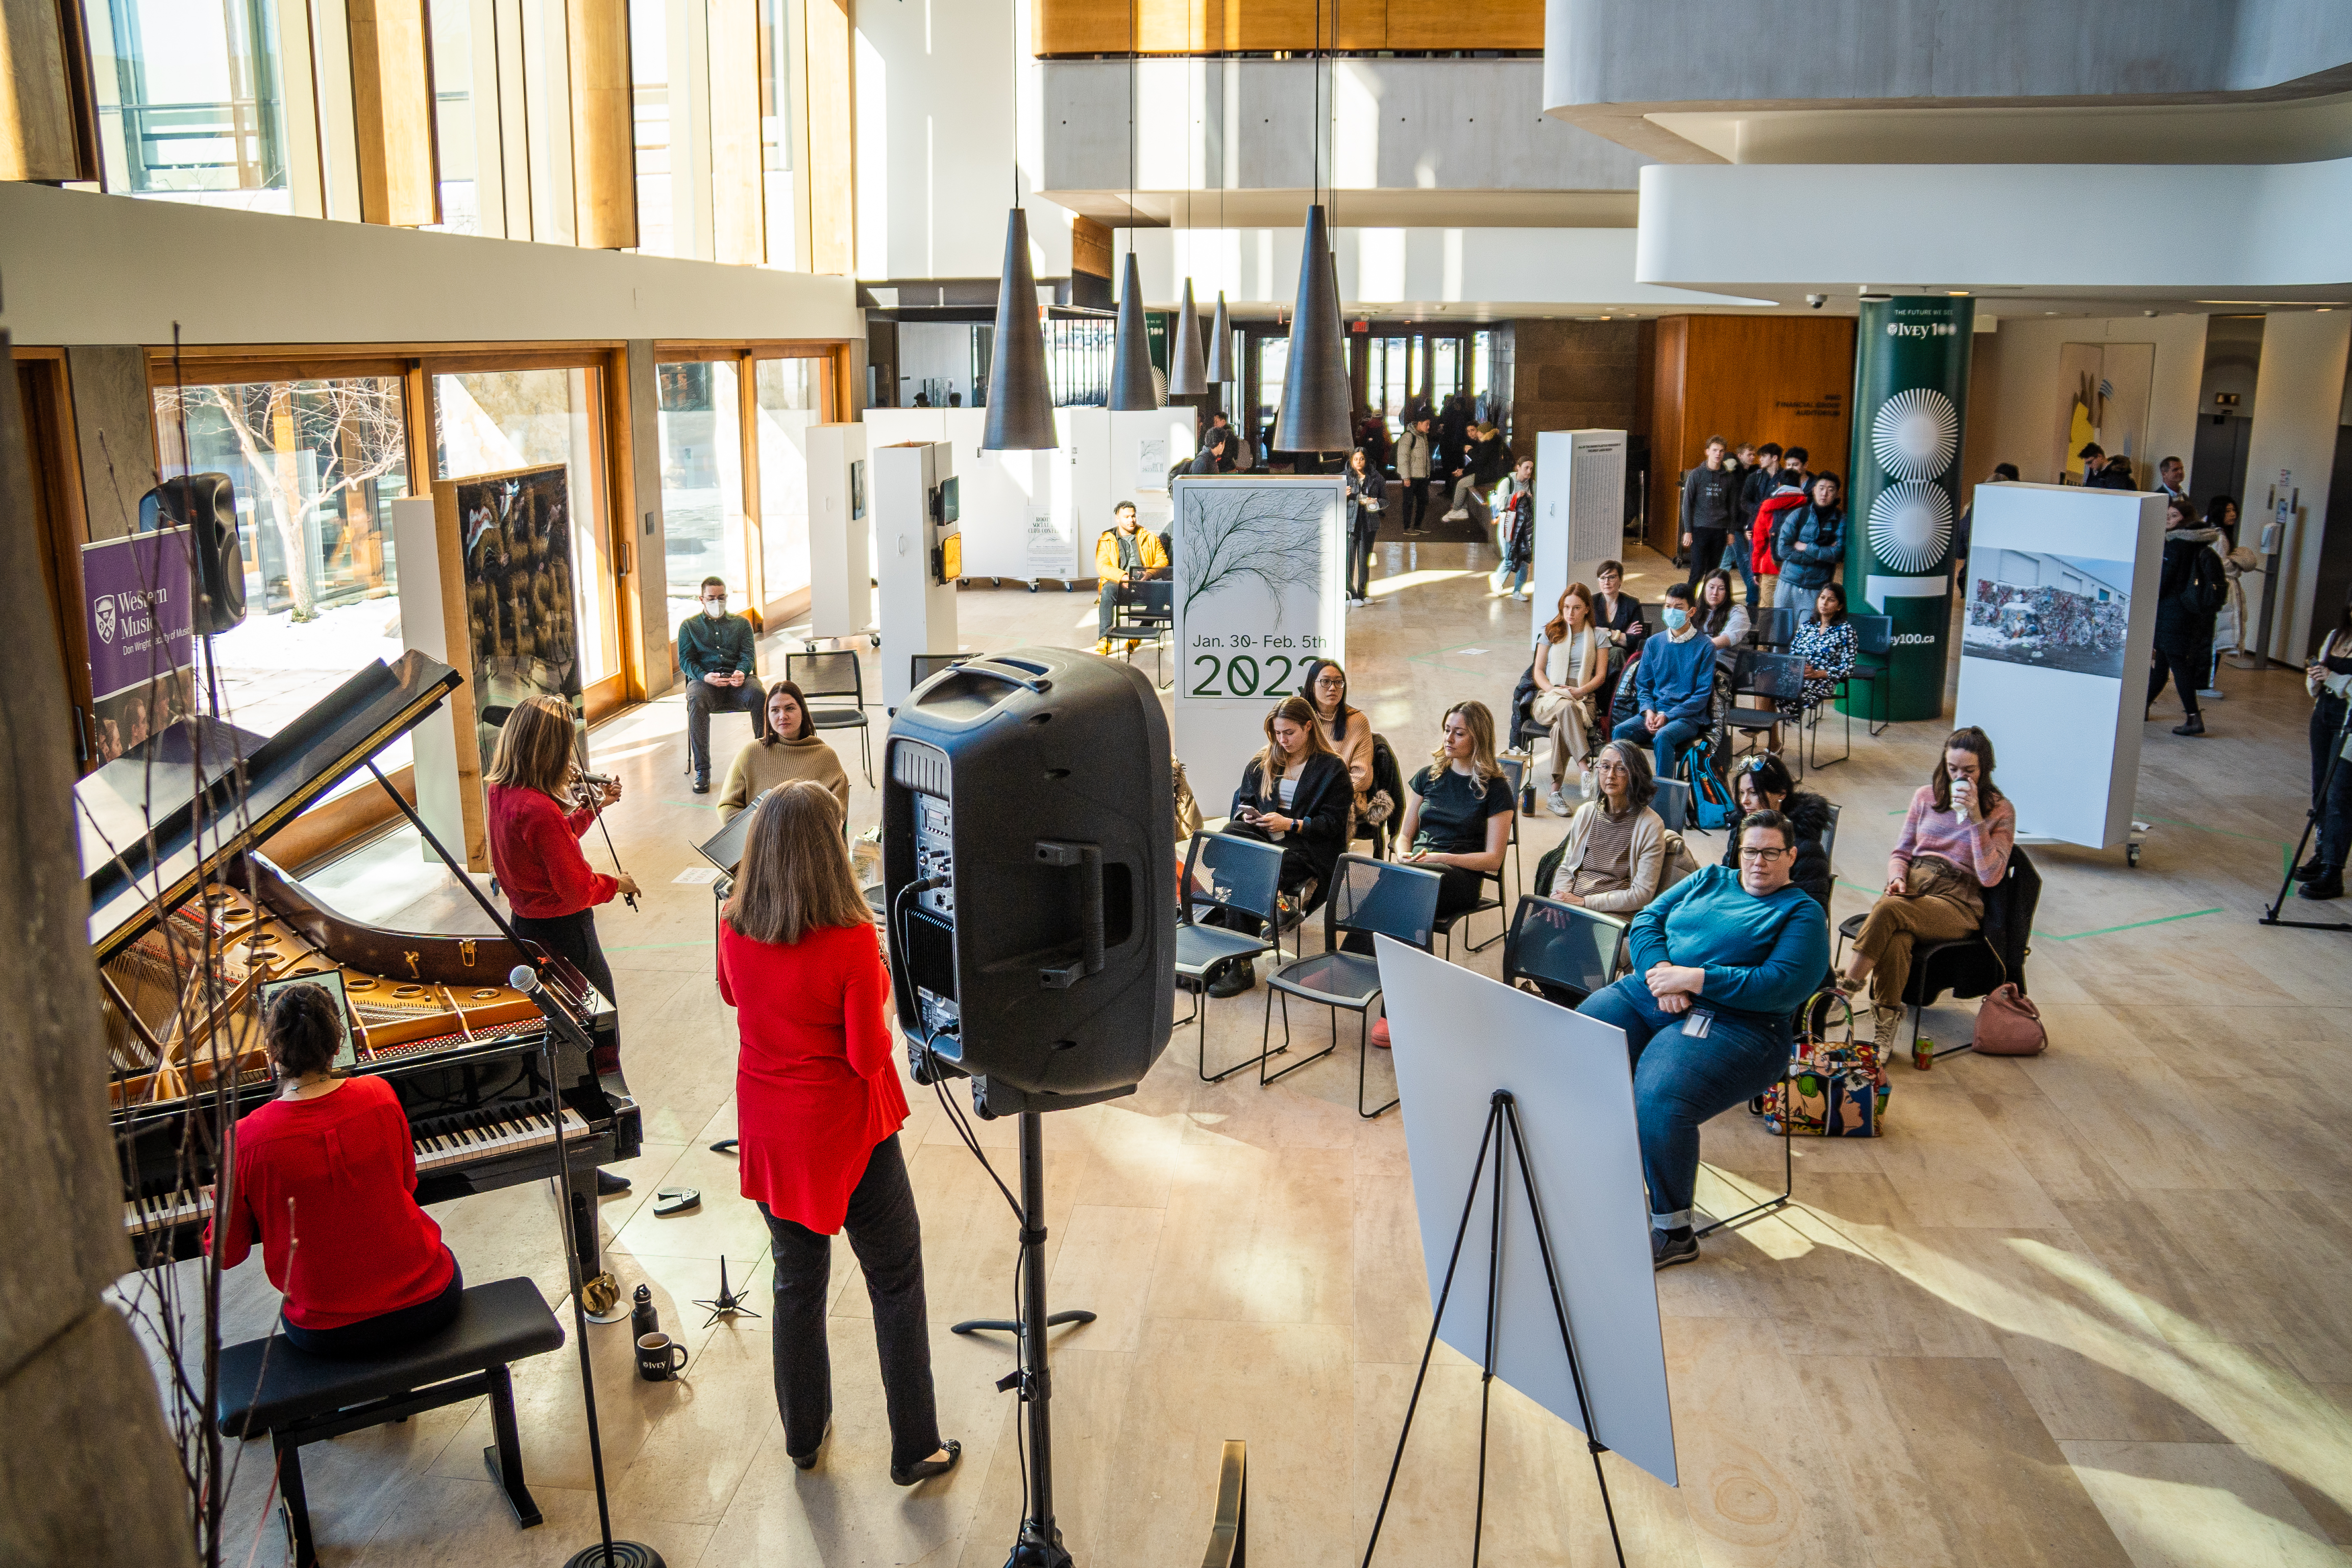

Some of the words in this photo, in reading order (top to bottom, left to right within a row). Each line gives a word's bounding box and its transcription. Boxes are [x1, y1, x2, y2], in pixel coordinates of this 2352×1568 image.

[123, 645, 134, 655] Don
[134, 638, 152, 651] Wright
[170, 629, 176, 640] of
[1192, 634, 1224, 648] Jan.
[1264, 634, 1296, 648] Feb.
[1302, 635, 1327, 648] 5th
